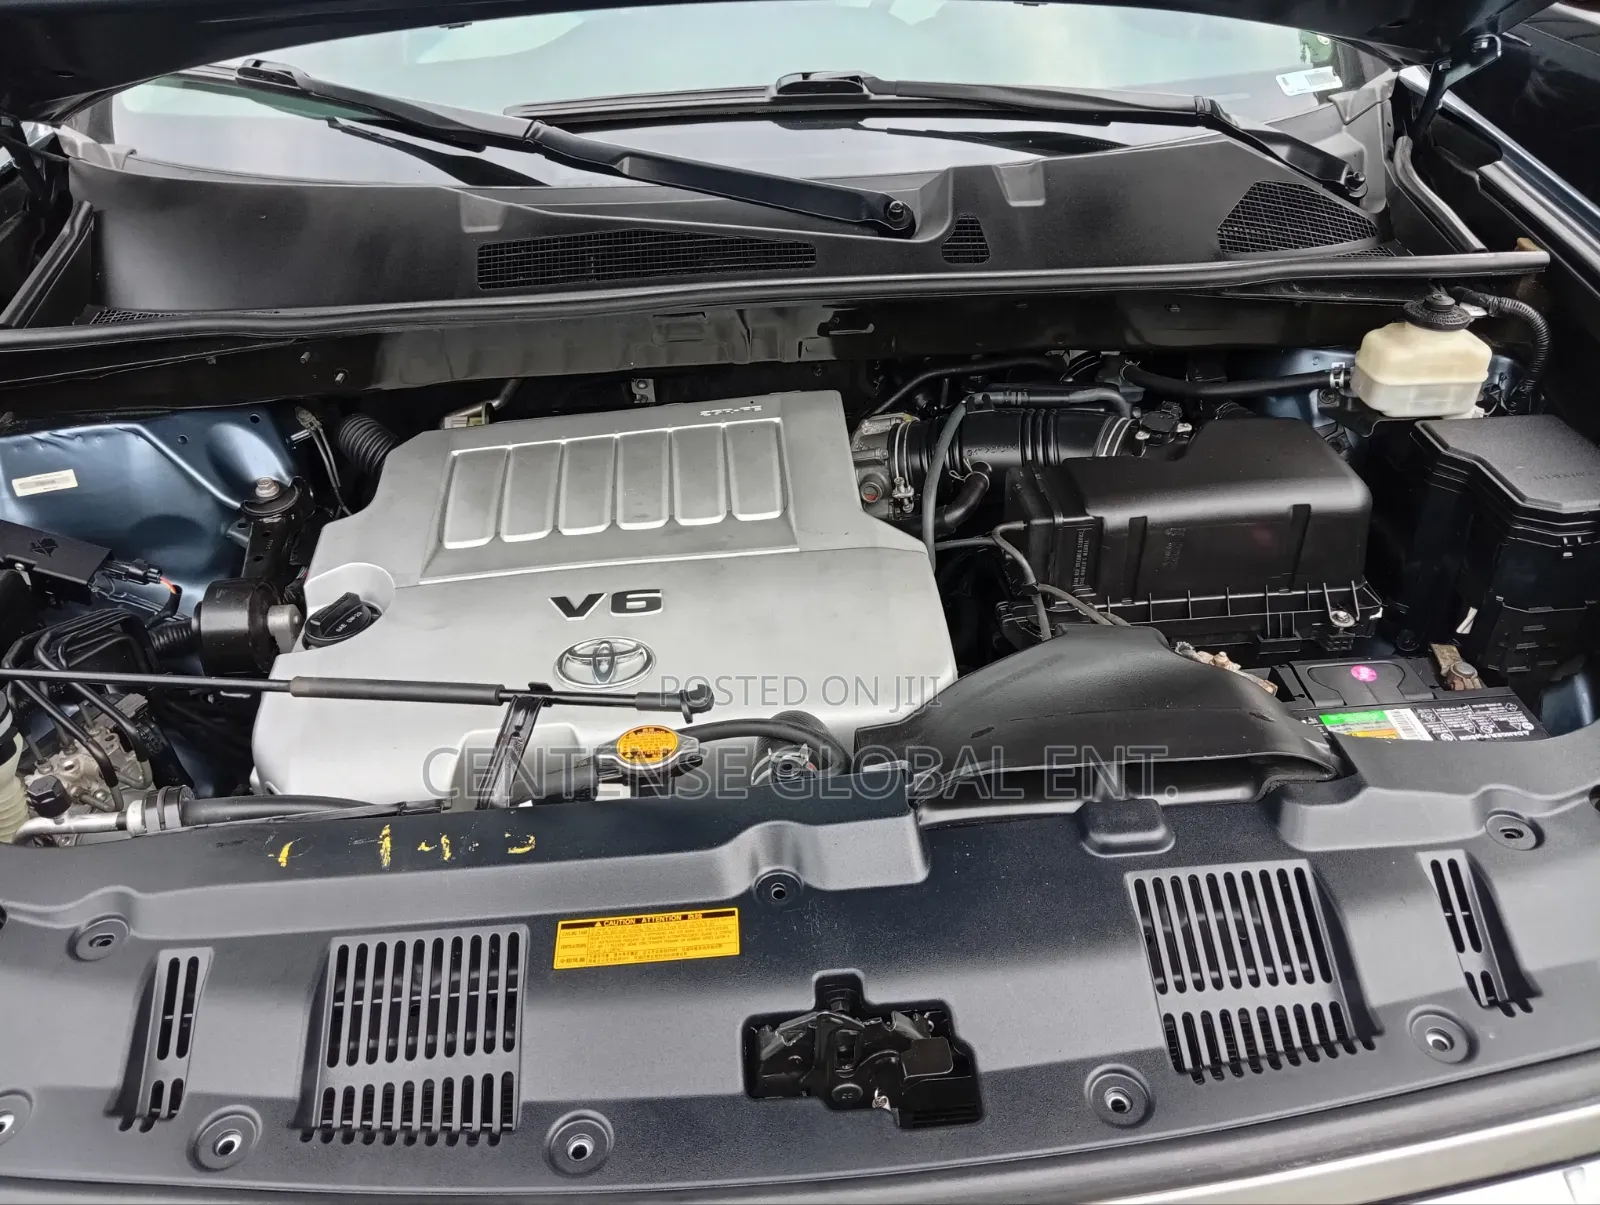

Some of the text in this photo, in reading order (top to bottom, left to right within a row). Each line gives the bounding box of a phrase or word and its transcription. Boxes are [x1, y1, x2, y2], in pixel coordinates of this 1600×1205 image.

[548, 589, 663, 621] V6
[603, 918, 636, 927] CAUTION
[641, 914, 682, 924] ATTENTION
